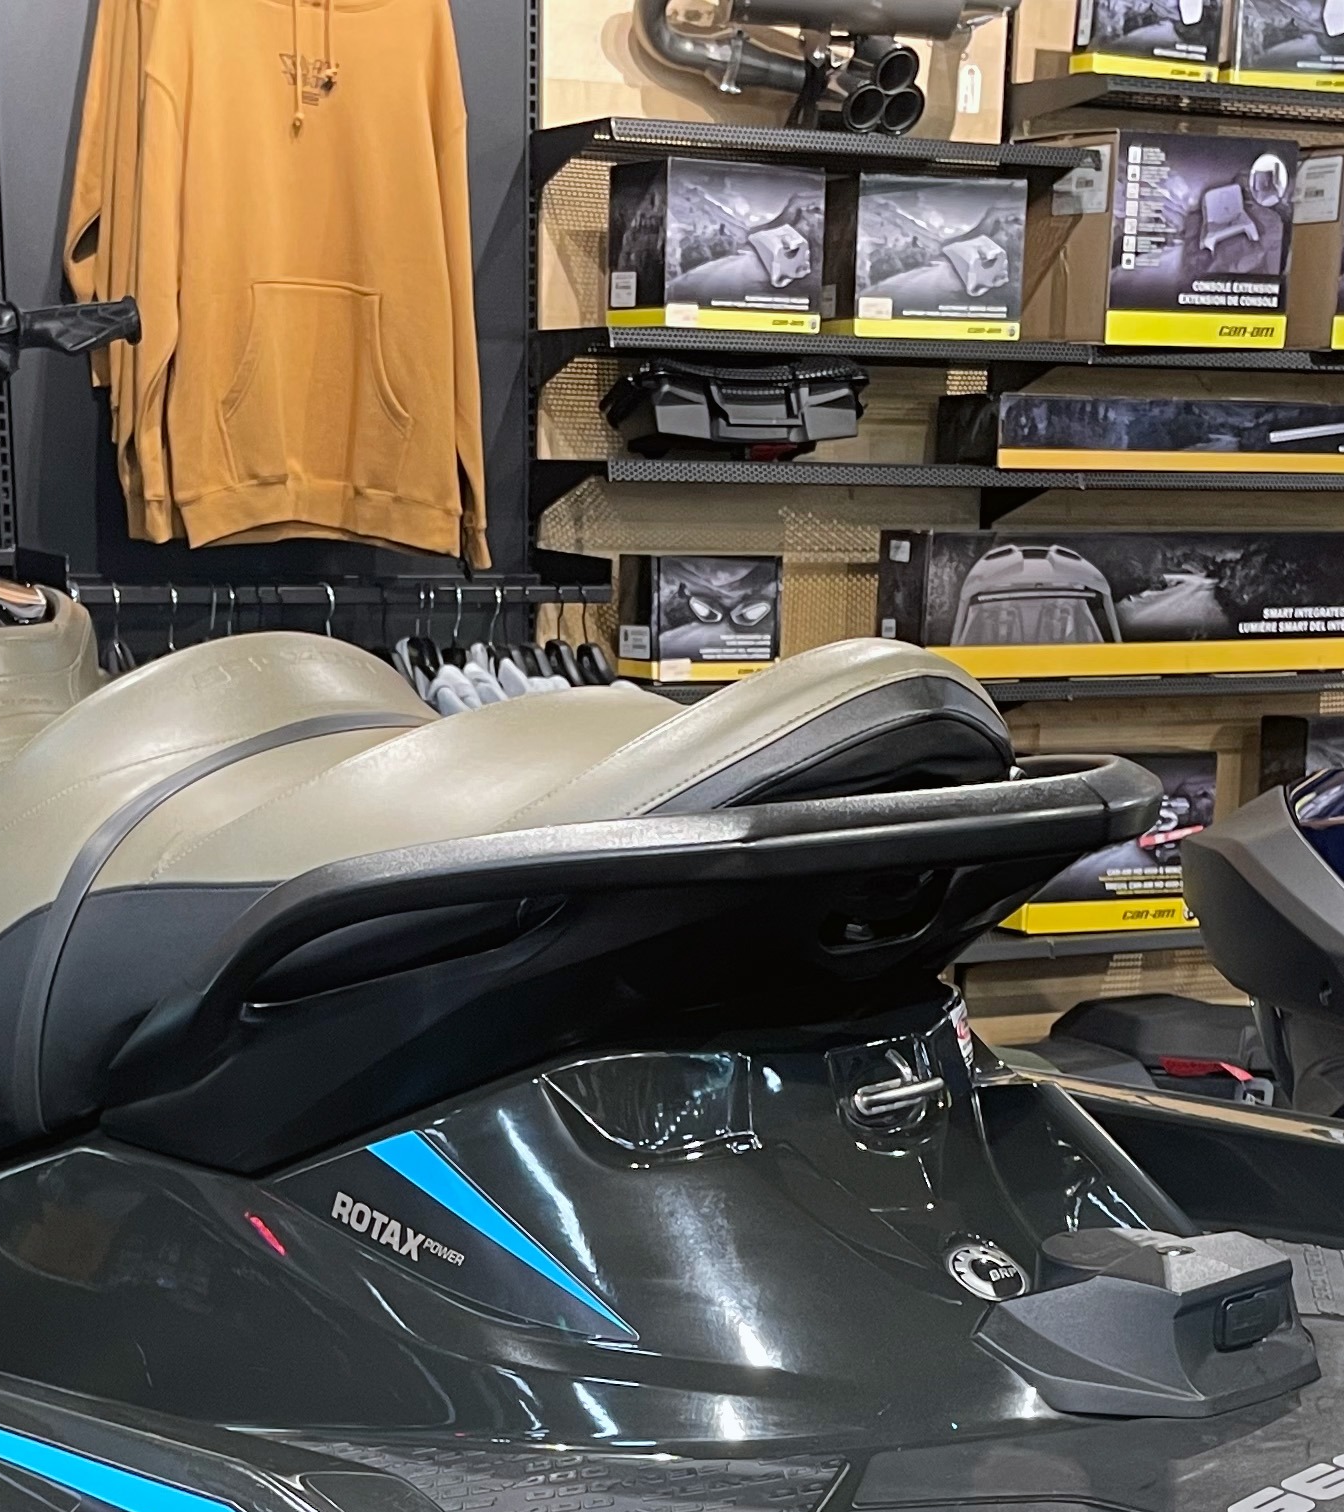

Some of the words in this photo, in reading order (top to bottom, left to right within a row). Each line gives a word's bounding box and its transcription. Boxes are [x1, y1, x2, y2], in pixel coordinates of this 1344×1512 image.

[1263, 607, 1293, 619] SMART
[1278, 620, 1308, 632] SMART
[331, 1191, 425, 1261] ROTAX
[423, 1238, 465, 1266] POWER
